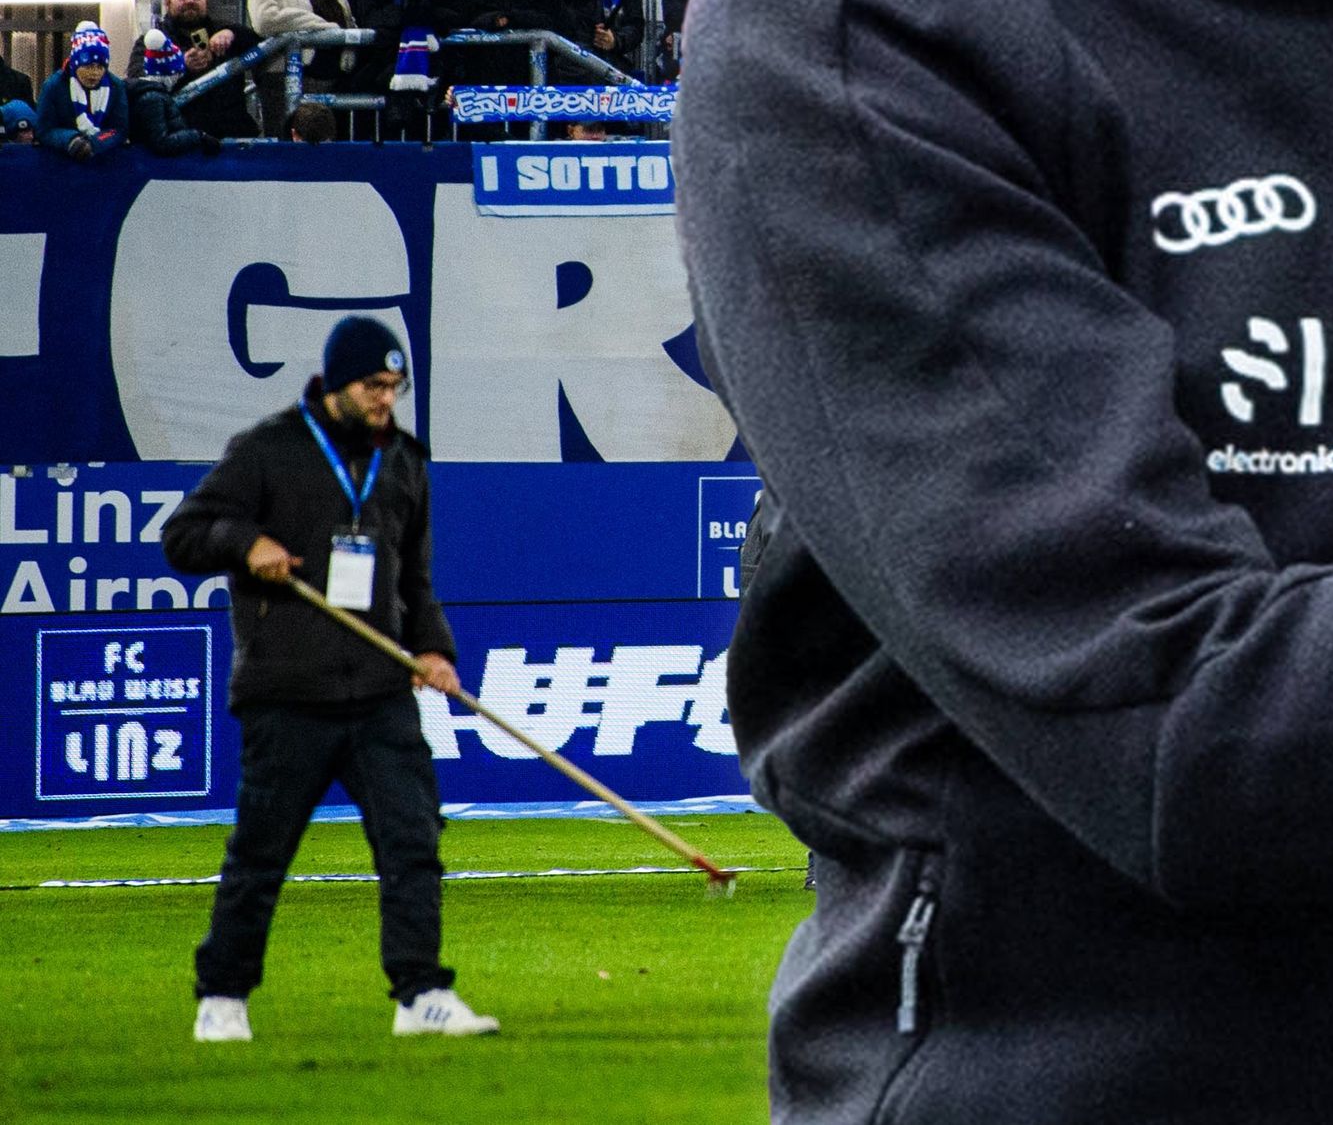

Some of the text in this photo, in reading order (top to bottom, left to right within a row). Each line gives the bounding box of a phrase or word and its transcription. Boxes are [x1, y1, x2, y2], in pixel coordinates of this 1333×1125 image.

[480, 155, 678, 193] I SOTTO
[0, 464, 184, 544] Linz
[709, 520, 748, 540] BLA
[103, 641, 146, 674] FC
[50, 678, 200, 703] BLAU WEISS
[64, 722, 184, 781] LINZ
